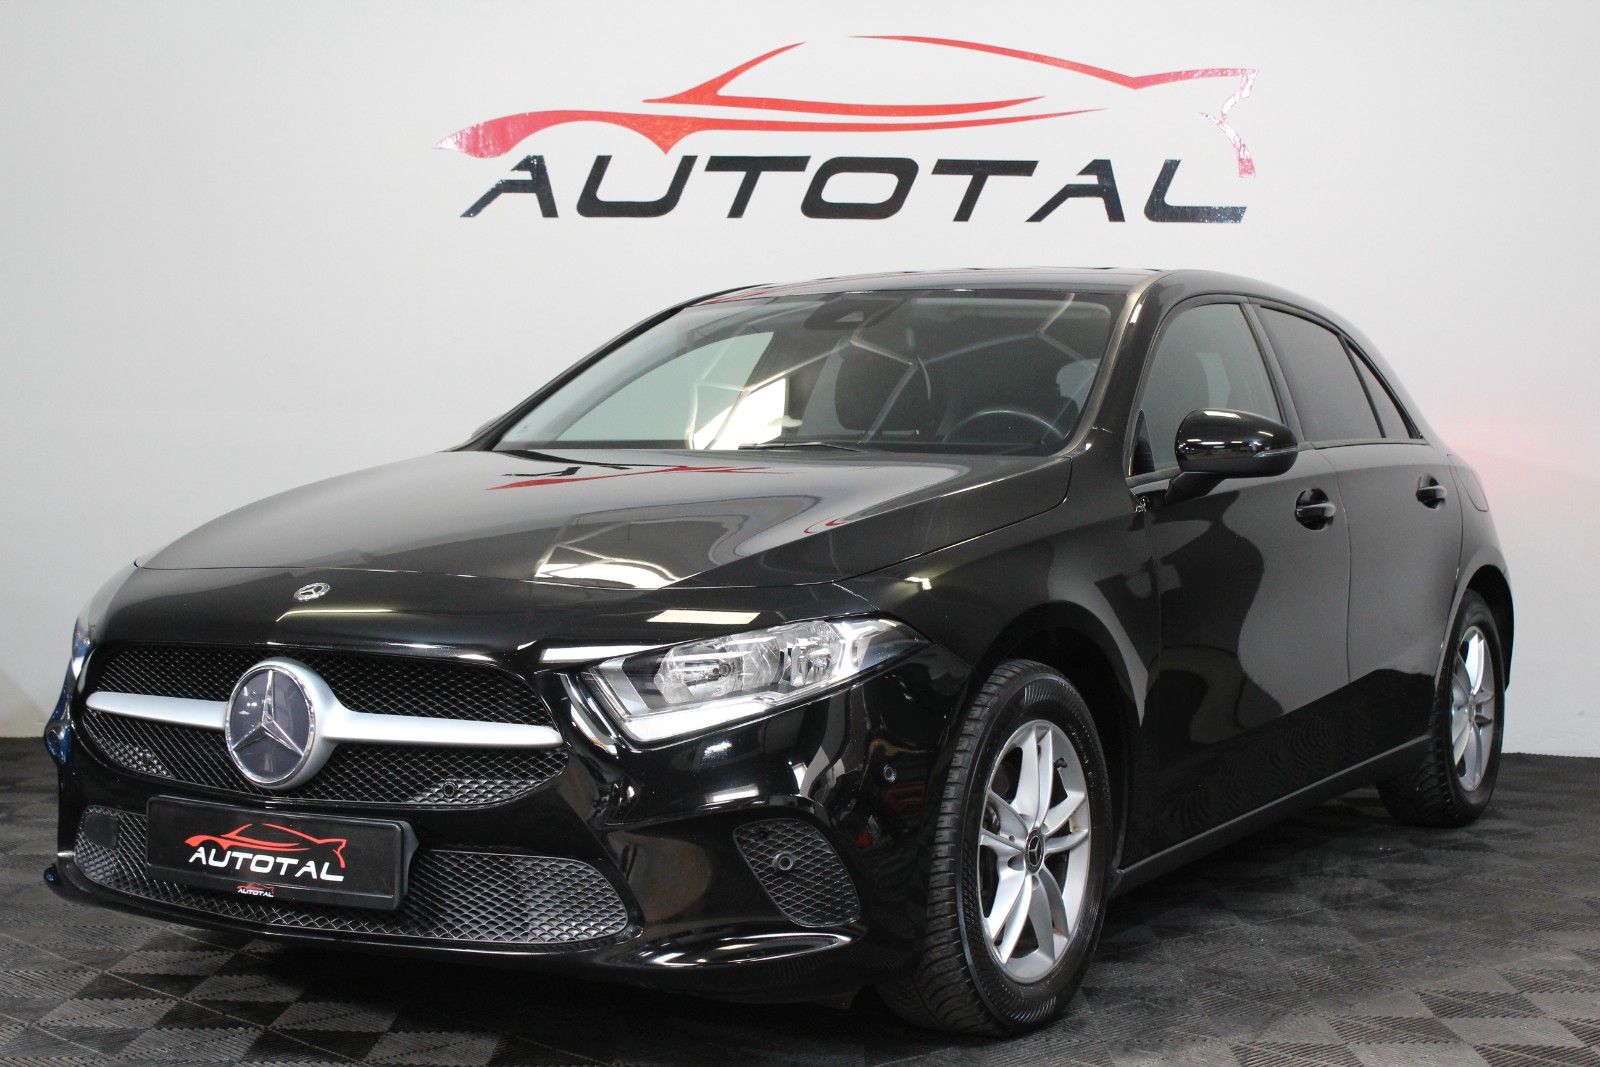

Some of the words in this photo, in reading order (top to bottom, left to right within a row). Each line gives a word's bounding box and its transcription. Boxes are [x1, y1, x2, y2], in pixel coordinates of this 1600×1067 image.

[460, 154, 1246, 224] AUTOTAL
[189, 846, 345, 882] AUTOTAL
[237, 888, 274, 898] AUTOTAL
